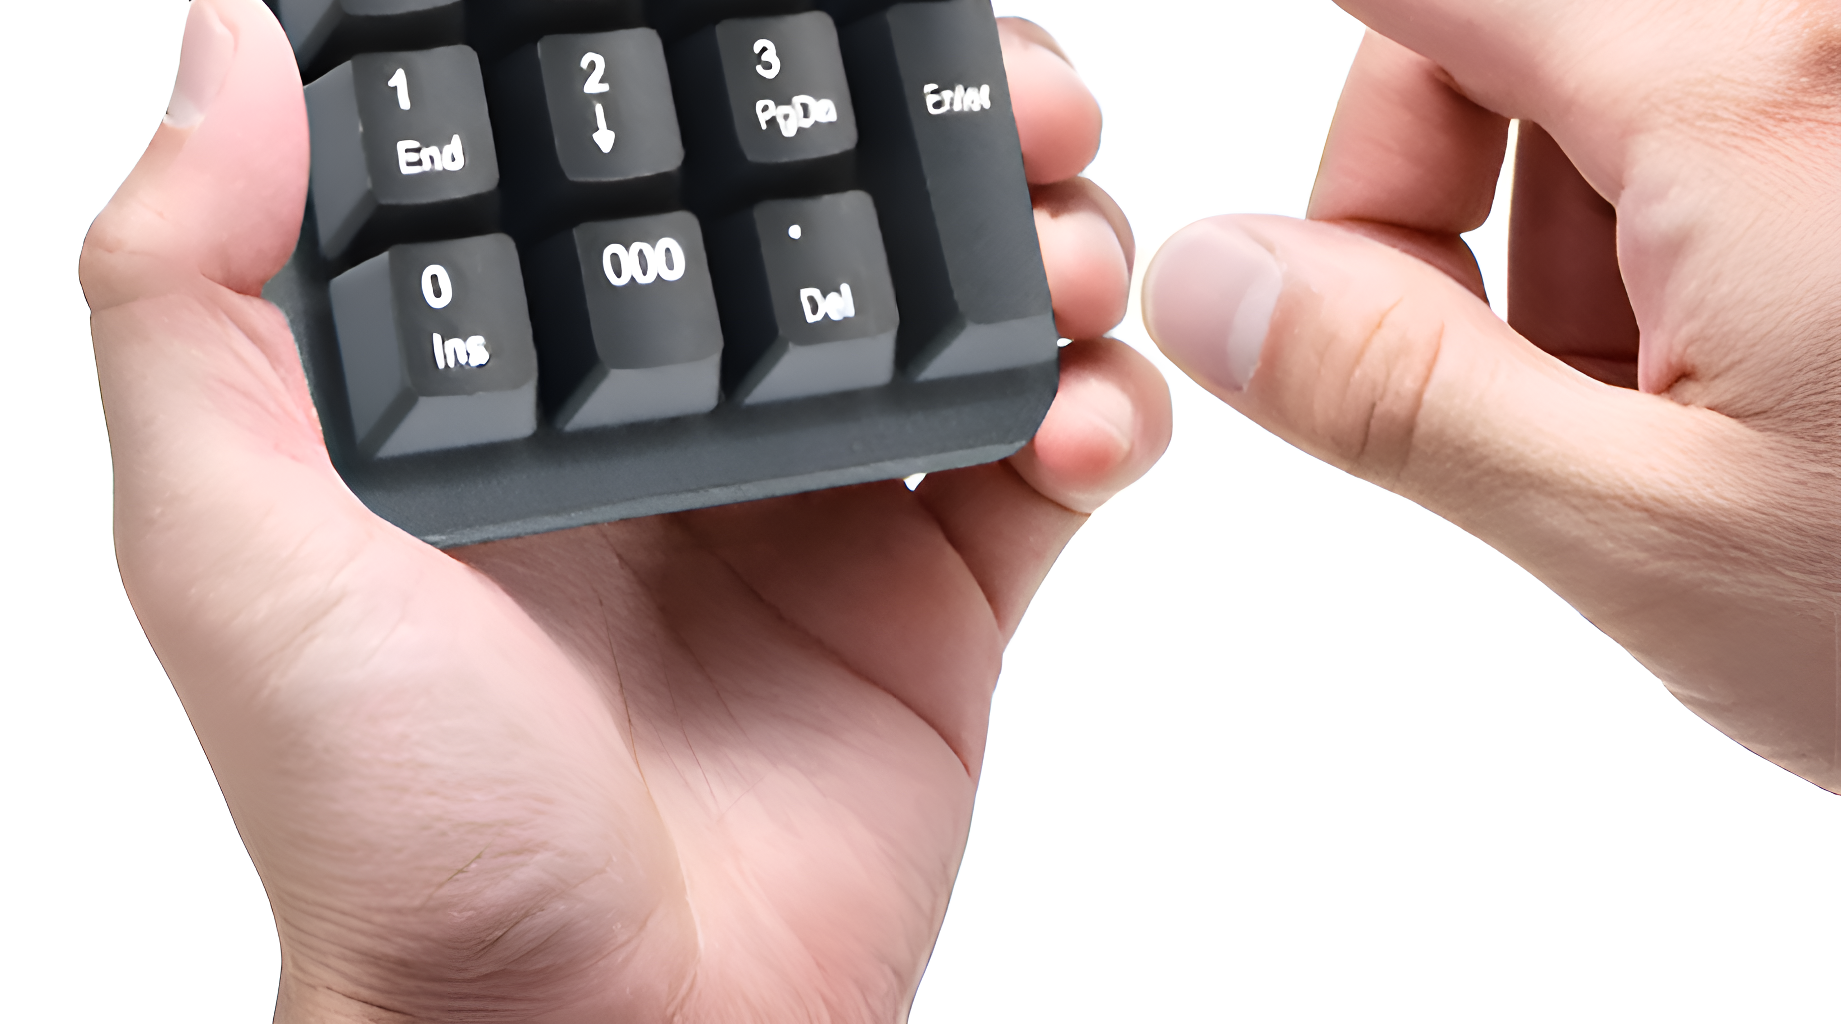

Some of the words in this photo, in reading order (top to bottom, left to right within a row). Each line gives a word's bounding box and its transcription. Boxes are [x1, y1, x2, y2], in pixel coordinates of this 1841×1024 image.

[579, 51, 611, 95] 2
[752, 38, 781, 80] 3
[387, 67, 412, 111] 1
[396, 133, 469, 176] End
[602, 236, 687, 288] 000
[420, 264, 453, 309] 0
[799, 282, 856, 324] Del
[432, 332, 491, 370] Ins
